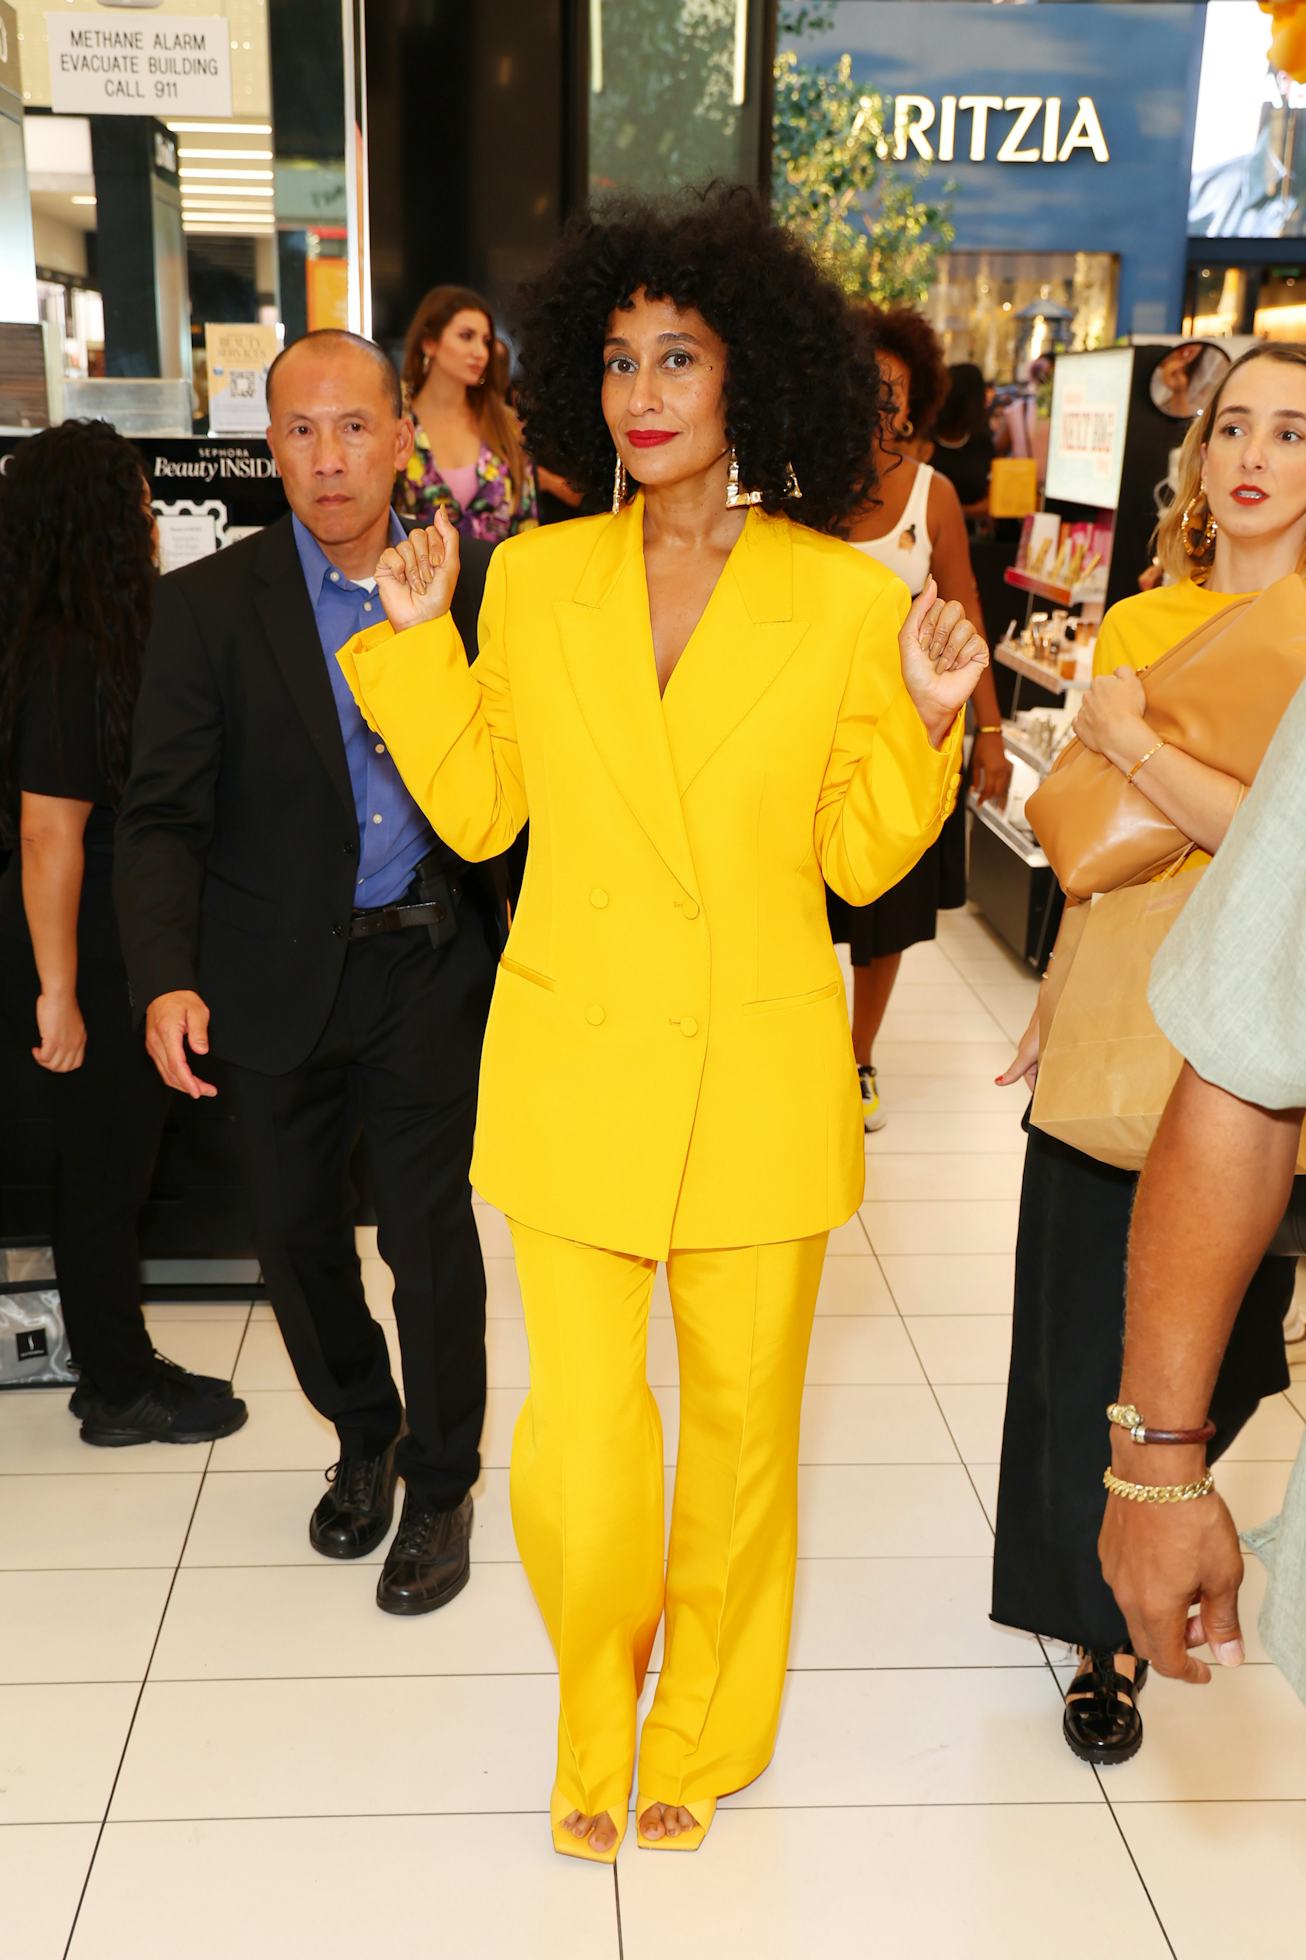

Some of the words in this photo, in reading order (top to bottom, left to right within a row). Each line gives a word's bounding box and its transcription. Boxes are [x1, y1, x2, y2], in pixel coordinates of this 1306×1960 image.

[70, 30, 144, 50] METHANE
[153, 33, 206, 51] ALARM
[61, 54, 140, 74] EVACUATE
[148, 56, 219, 76] BUILDING
[104, 79, 145, 98] CALL
[154, 81, 179, 99] 911
[198, 447, 250, 458] SEPHORA
[154, 457, 219, 482] Beauty
